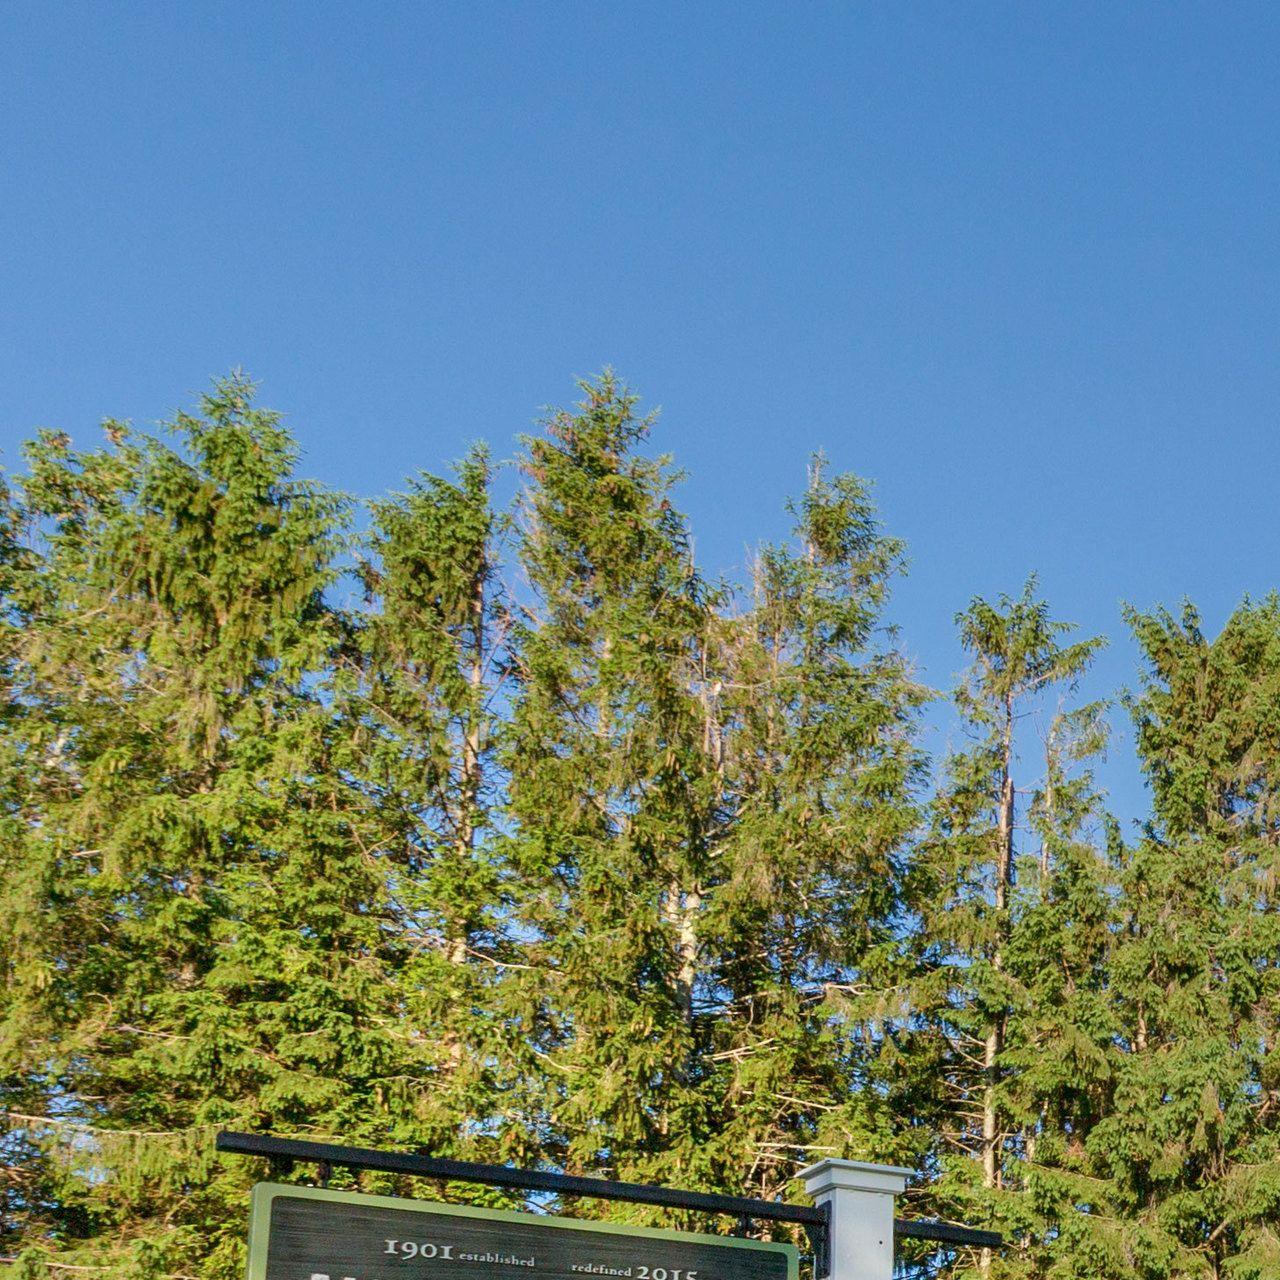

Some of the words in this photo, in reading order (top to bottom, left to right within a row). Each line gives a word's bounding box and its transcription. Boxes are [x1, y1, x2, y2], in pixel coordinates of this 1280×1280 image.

[384, 1239, 454, 1260] 1901
[459, 1252, 535, 1267] established
[571, 1263, 632, 1277] redefined
